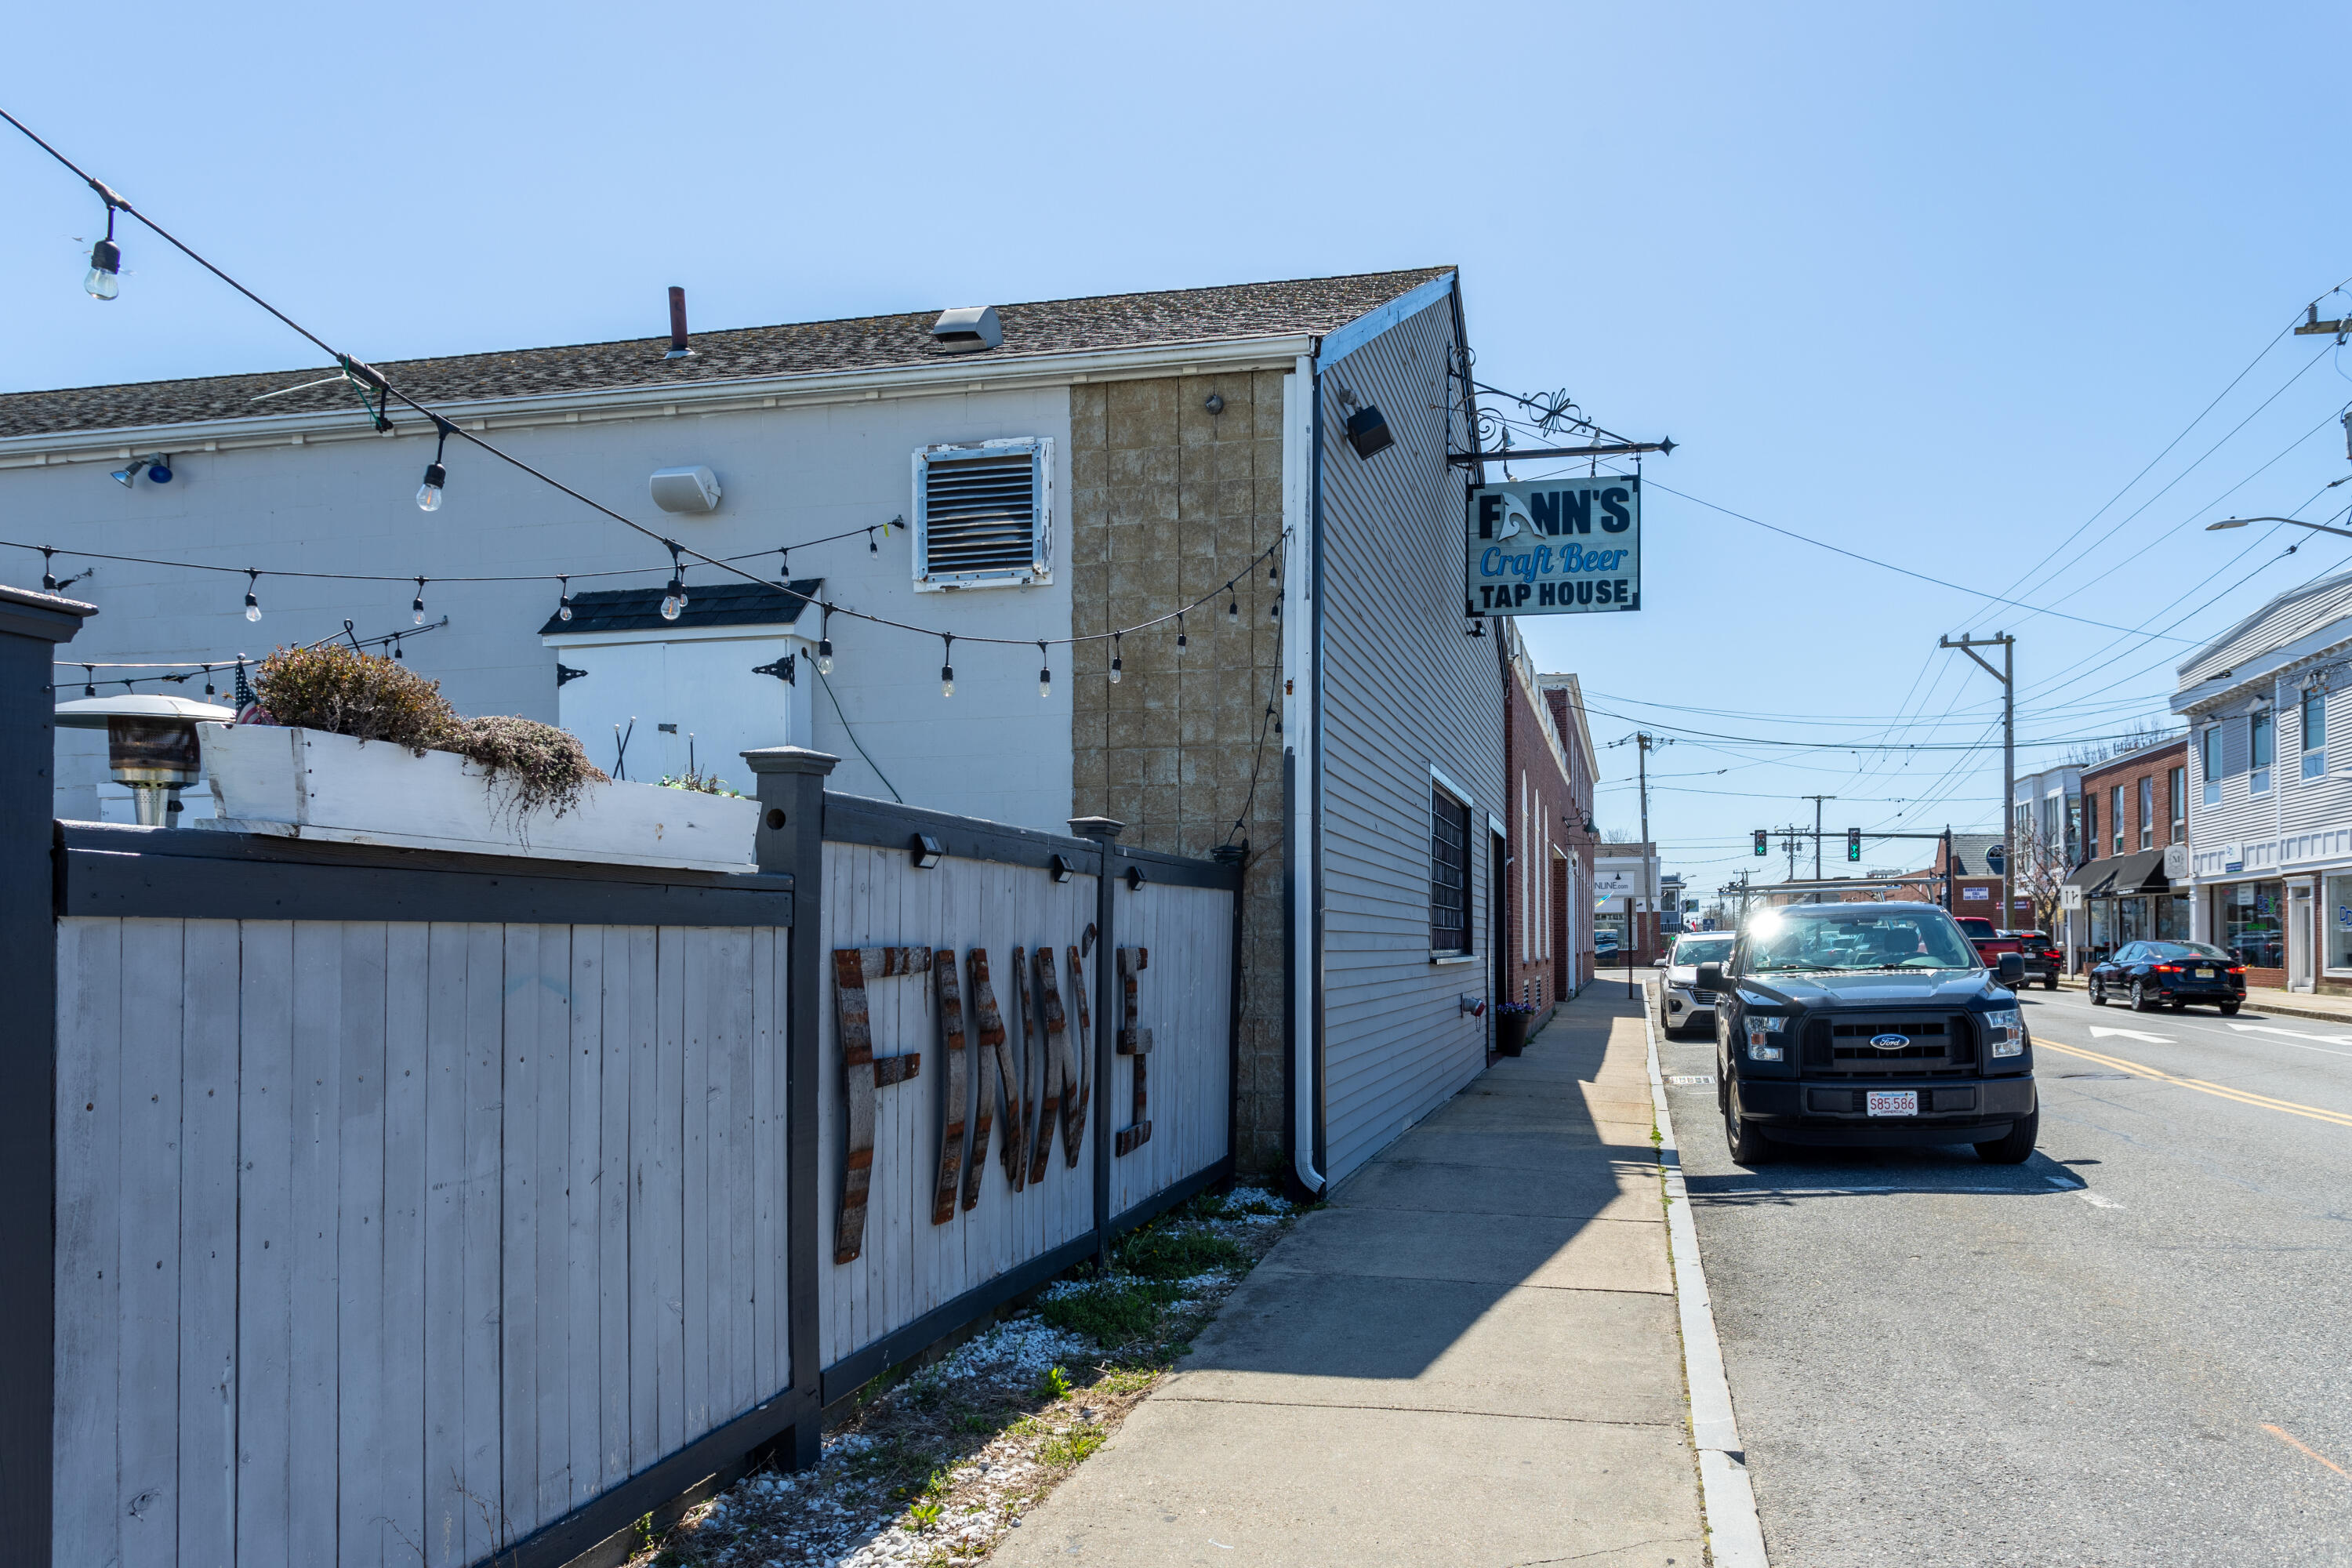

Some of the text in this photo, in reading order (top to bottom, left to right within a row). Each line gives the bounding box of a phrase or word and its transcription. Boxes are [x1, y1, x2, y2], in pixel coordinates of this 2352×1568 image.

[1480, 543, 1628, 583] Craft Beer
[1480, 579, 1628, 608] TAP HOUSE
[1879, 1036, 1900, 1047] Ford
